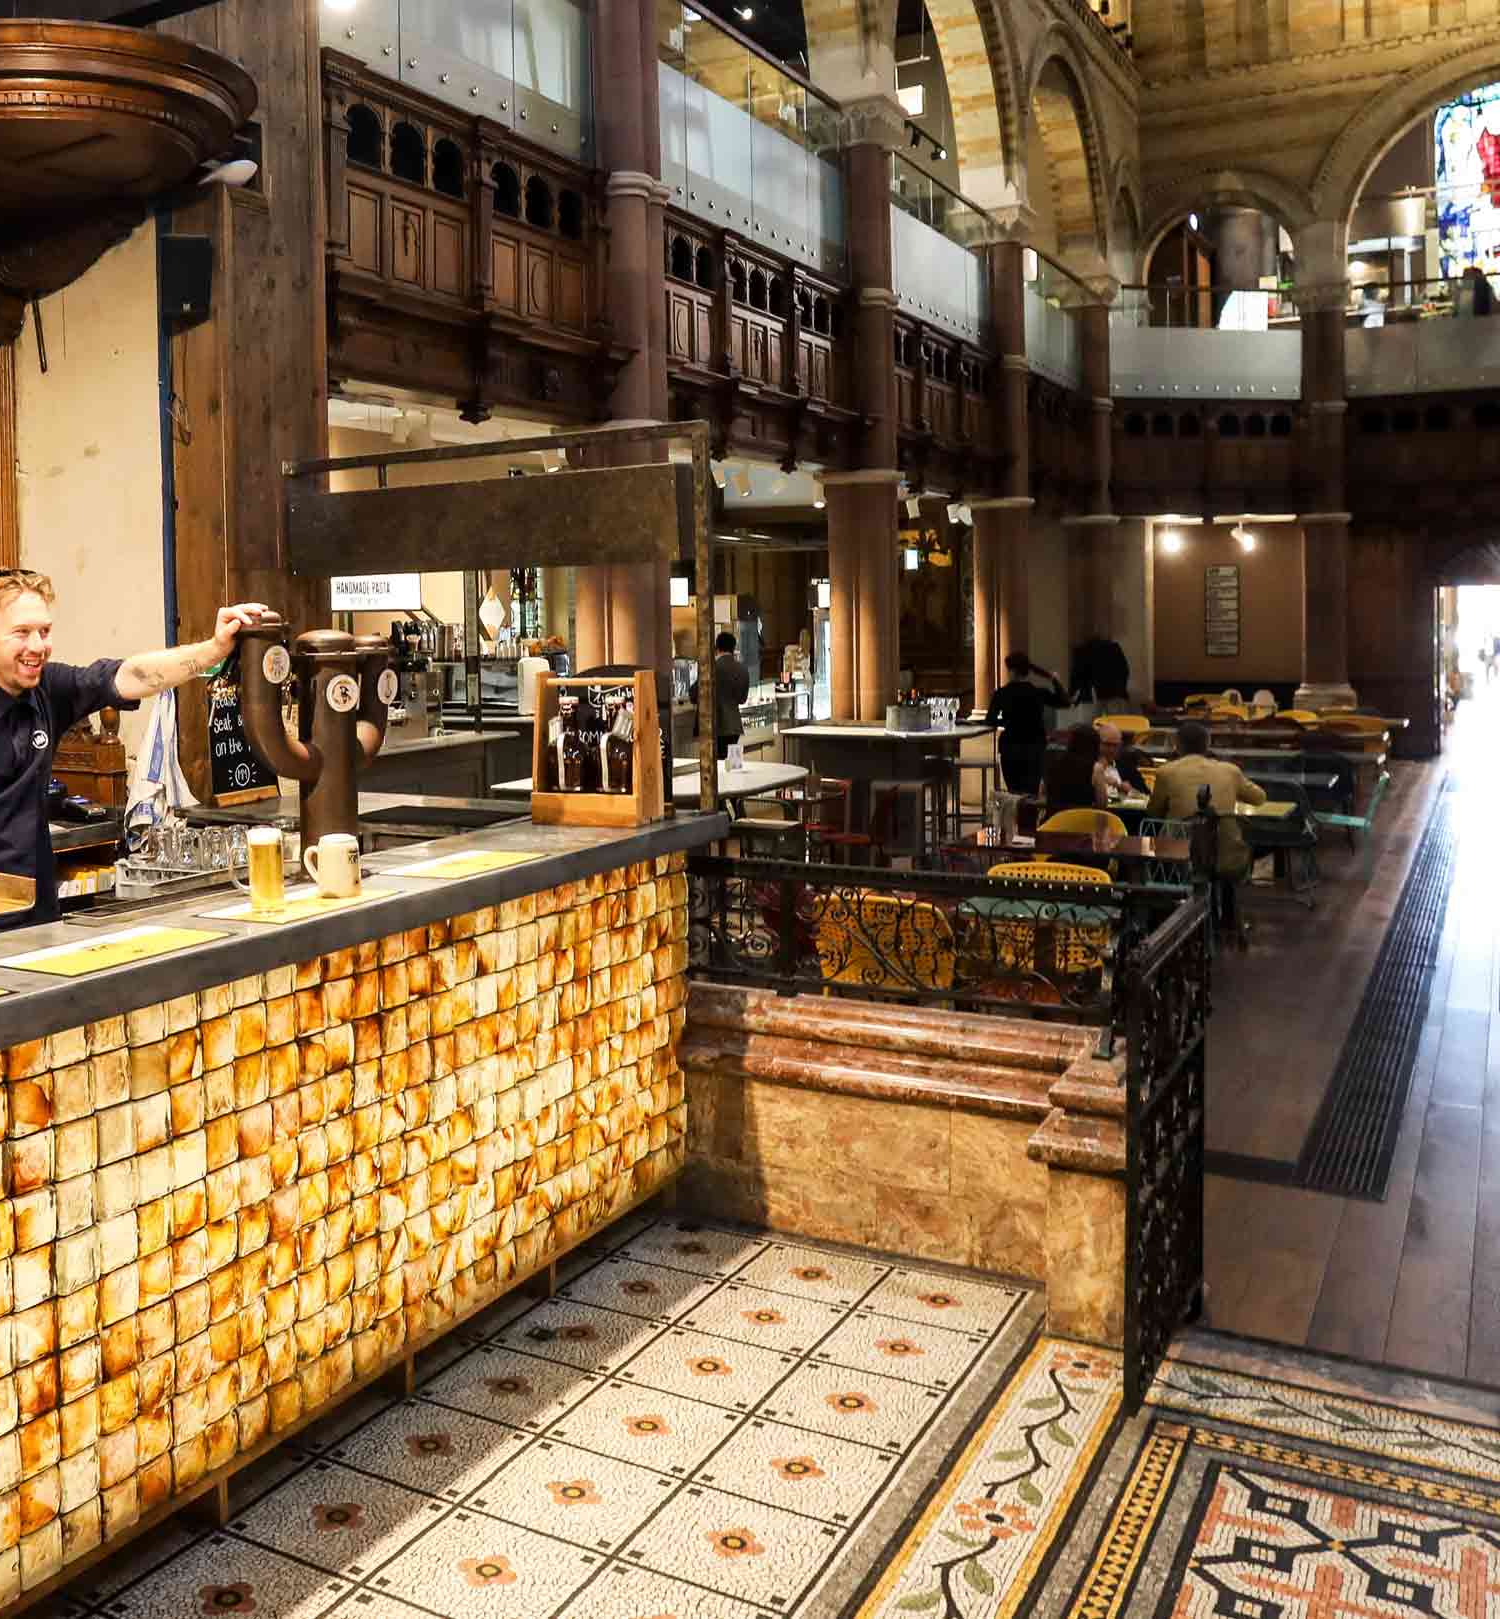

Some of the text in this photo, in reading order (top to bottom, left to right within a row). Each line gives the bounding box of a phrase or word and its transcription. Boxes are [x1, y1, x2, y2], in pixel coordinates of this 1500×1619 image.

[336, 581, 390, 594] HANDMADE PASTA
[215, 741, 227, 757] on
[228, 737, 244, 755] the
